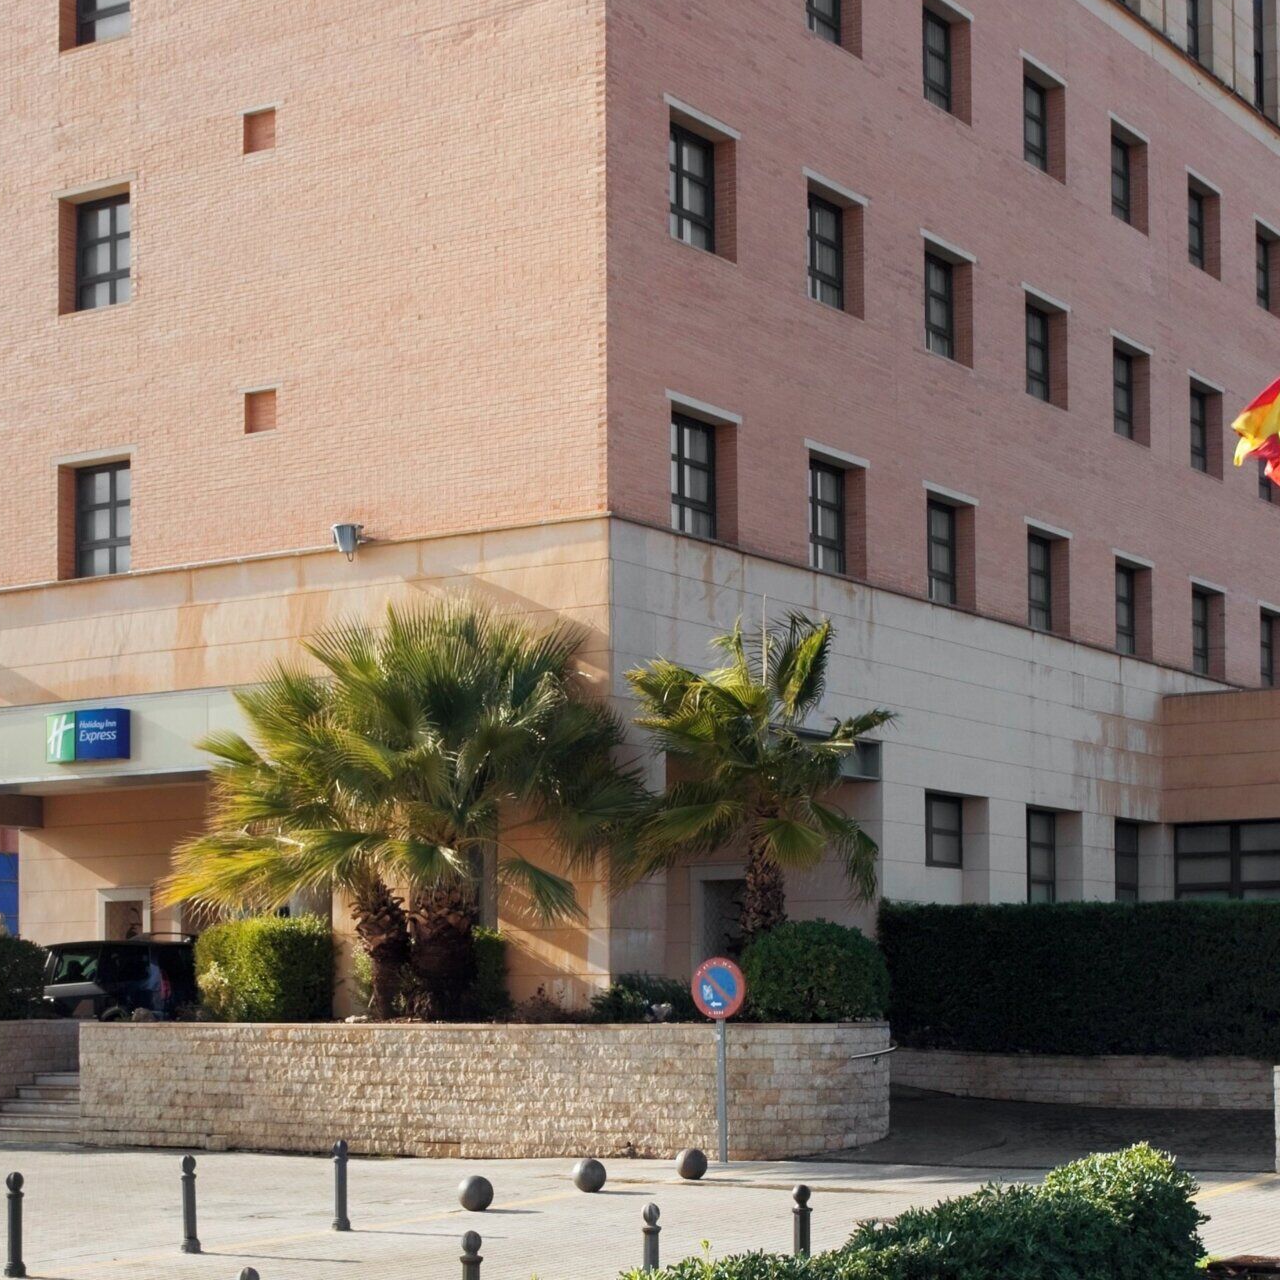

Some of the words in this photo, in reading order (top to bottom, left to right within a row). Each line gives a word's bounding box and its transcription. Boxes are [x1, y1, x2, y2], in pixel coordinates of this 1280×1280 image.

[79, 720, 104, 729] Holiday
[105, 719, 117, 727] Inn
[79, 730, 117, 743] Express
